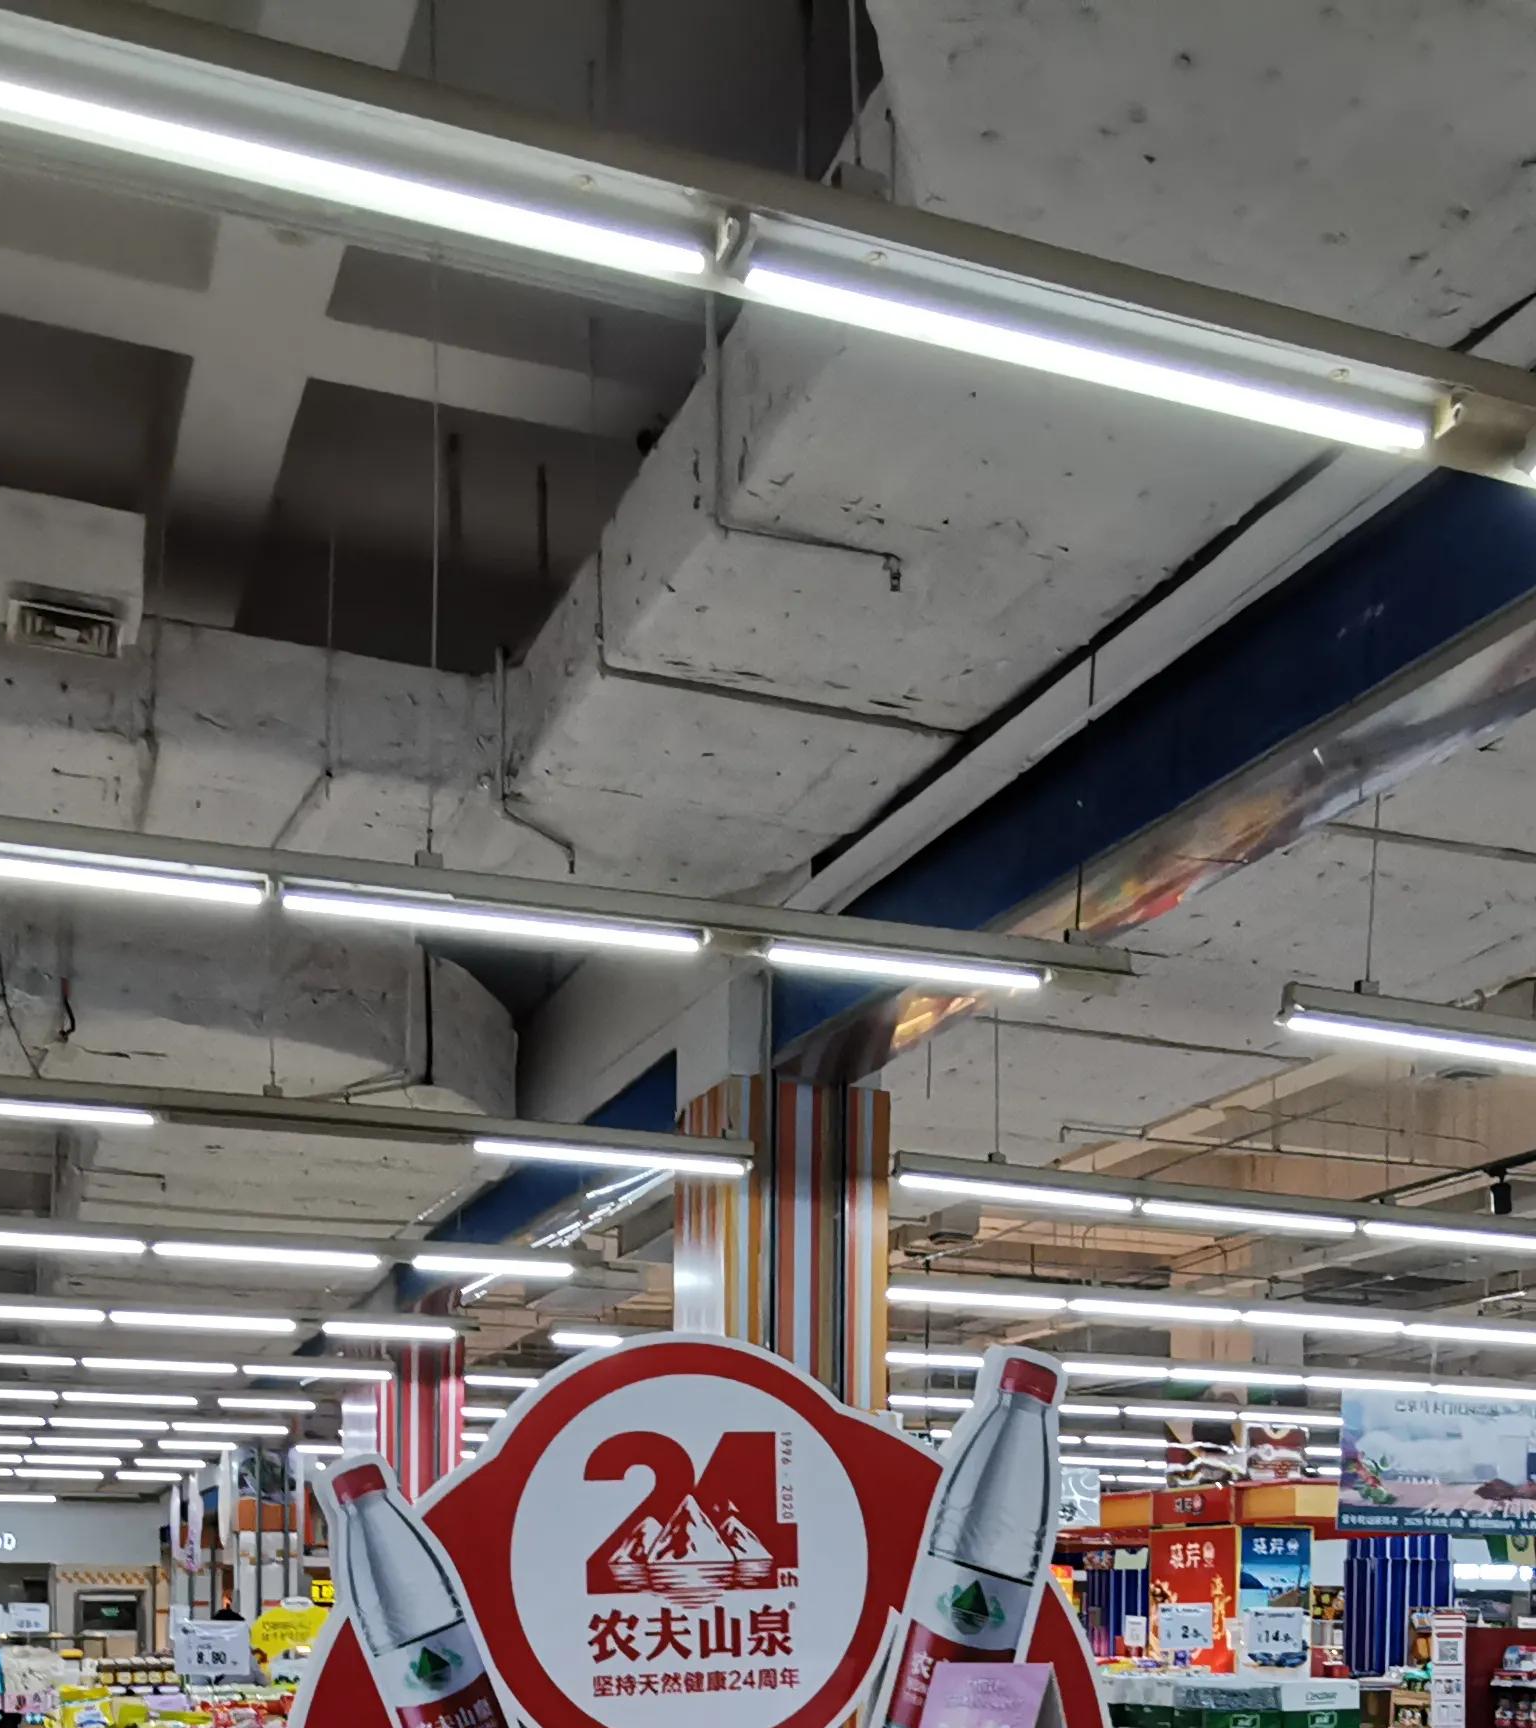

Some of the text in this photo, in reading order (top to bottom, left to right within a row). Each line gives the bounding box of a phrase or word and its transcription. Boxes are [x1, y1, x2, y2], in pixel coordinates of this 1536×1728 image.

[587, 1603, 794, 1664] 农夫山泉
[593, 1667, 800, 1697] 坚持天然健康24周年
